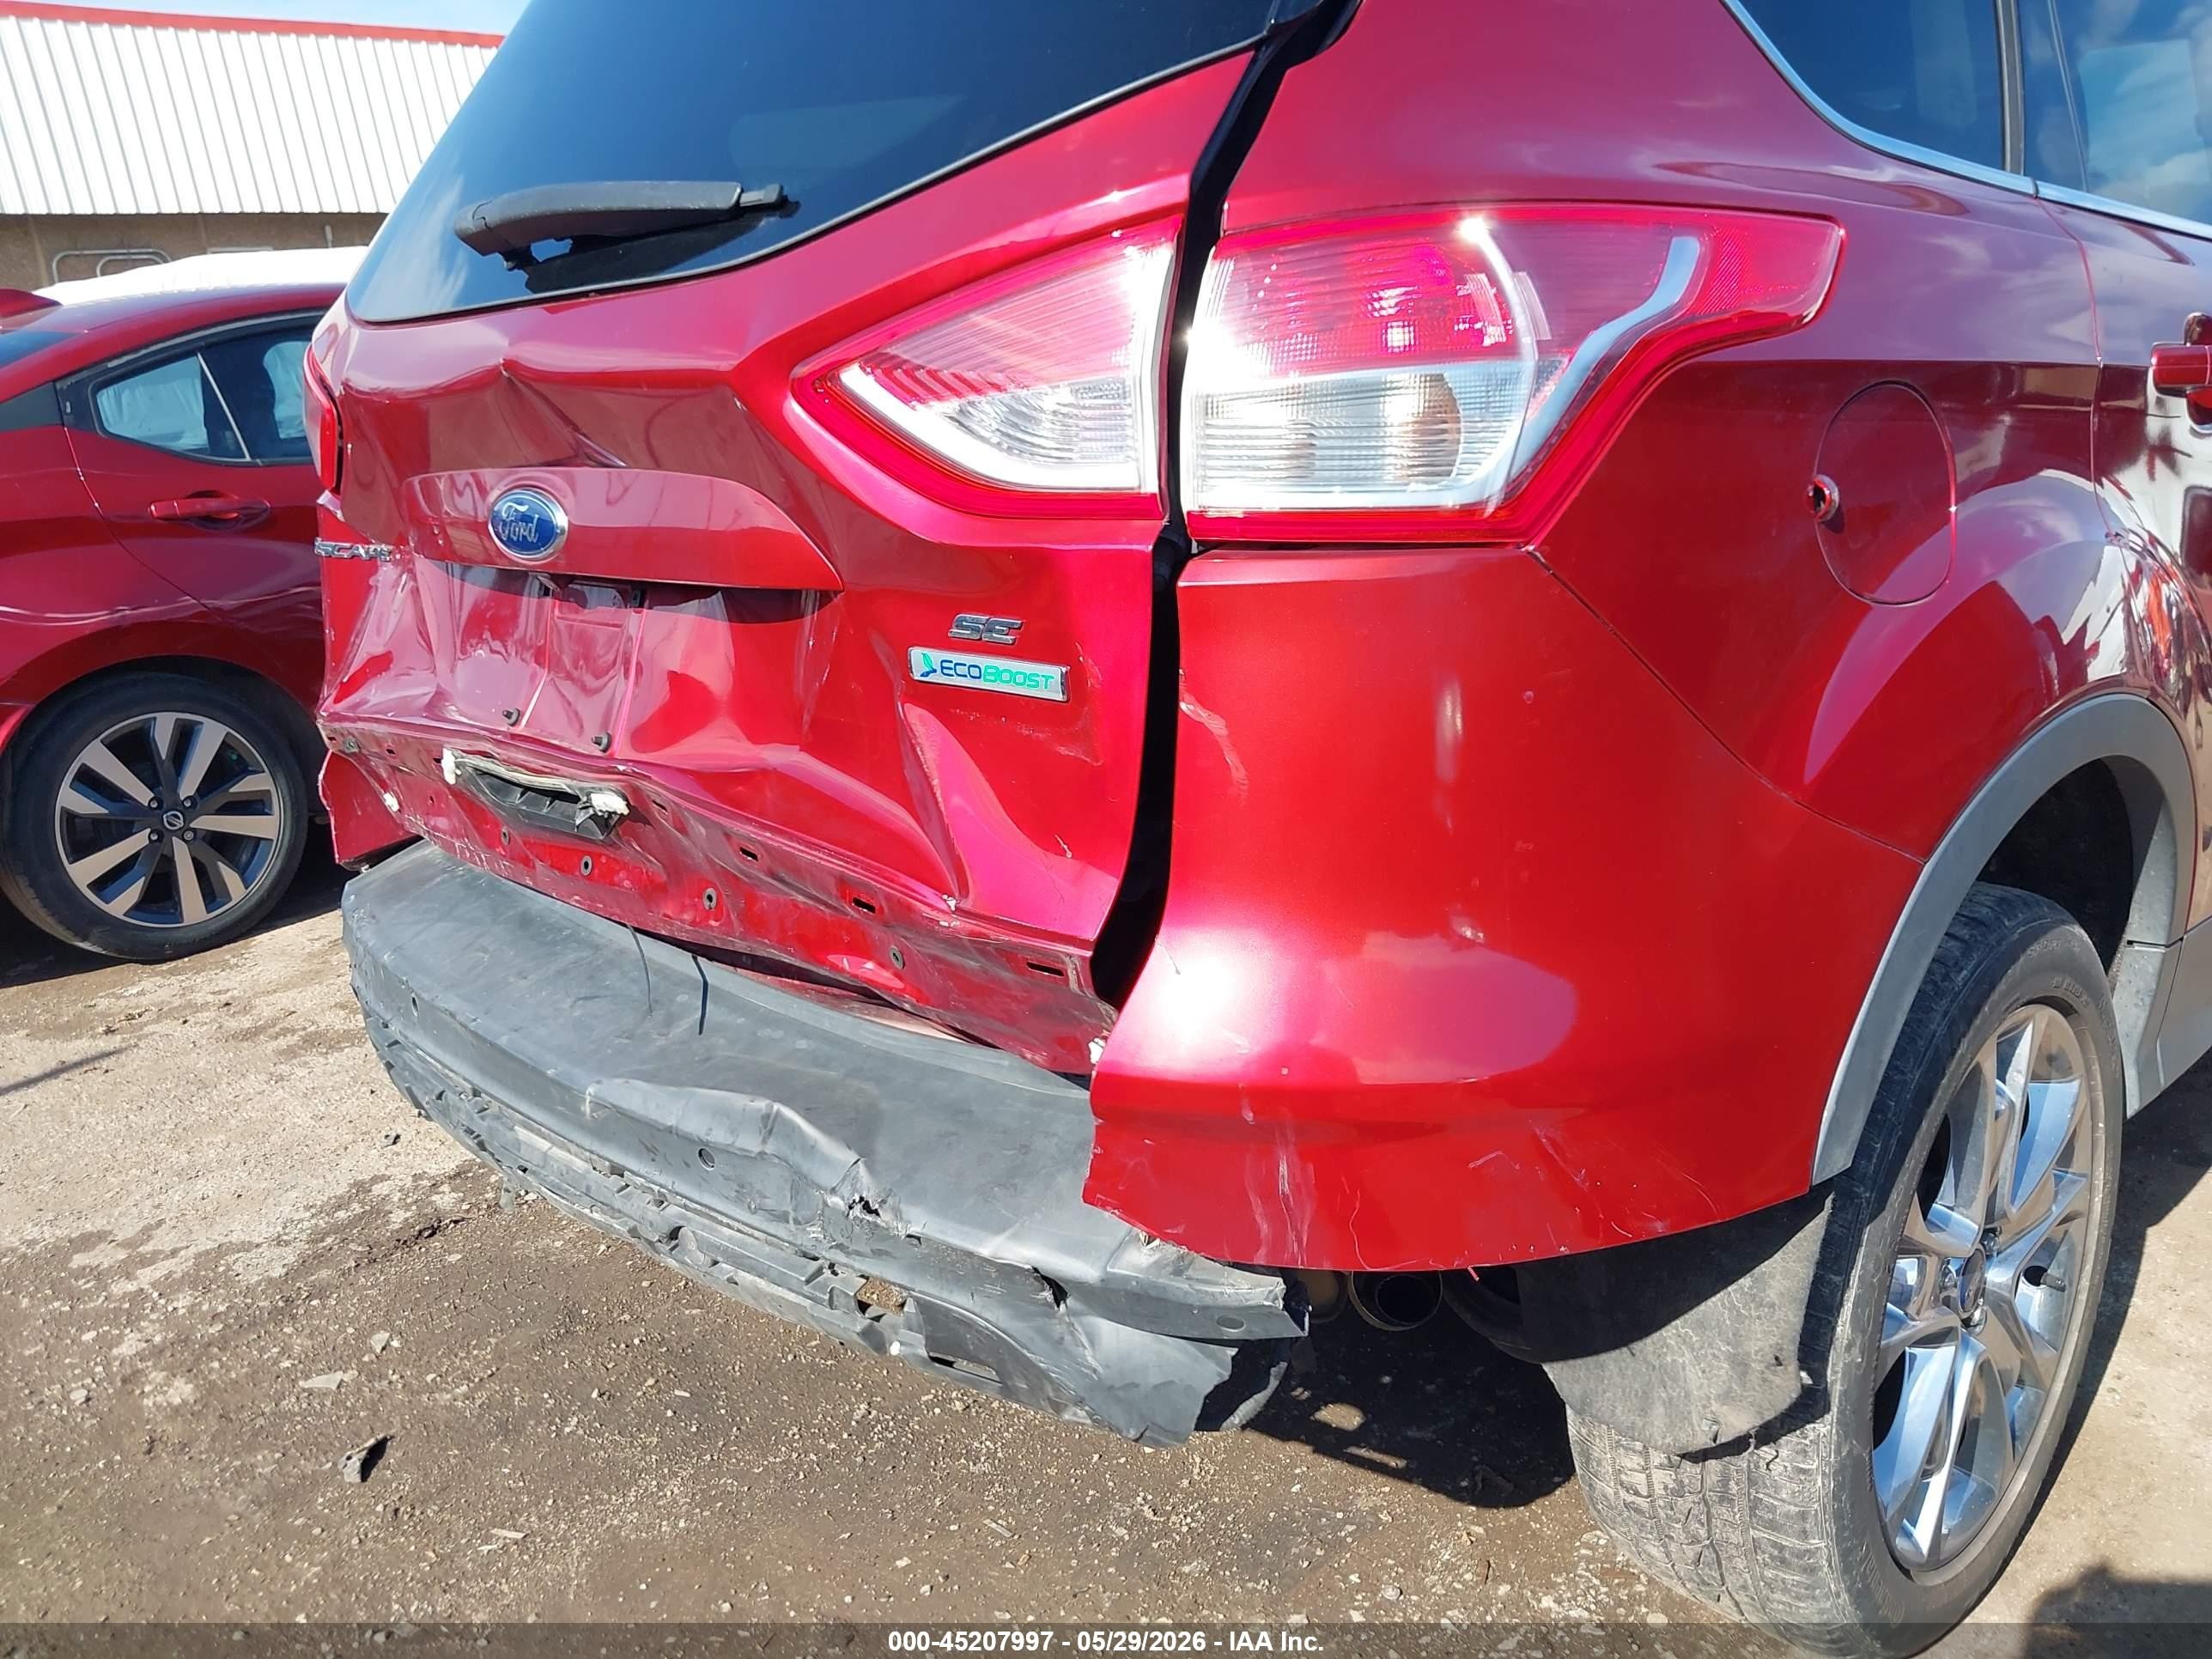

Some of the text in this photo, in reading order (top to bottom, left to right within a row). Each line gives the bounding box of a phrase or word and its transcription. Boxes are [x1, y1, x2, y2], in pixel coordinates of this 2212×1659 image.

[499, 501, 539, 544] Ford
[948, 613, 1024, 645] SE
[939, 659, 1055, 690] ECOBOOST
